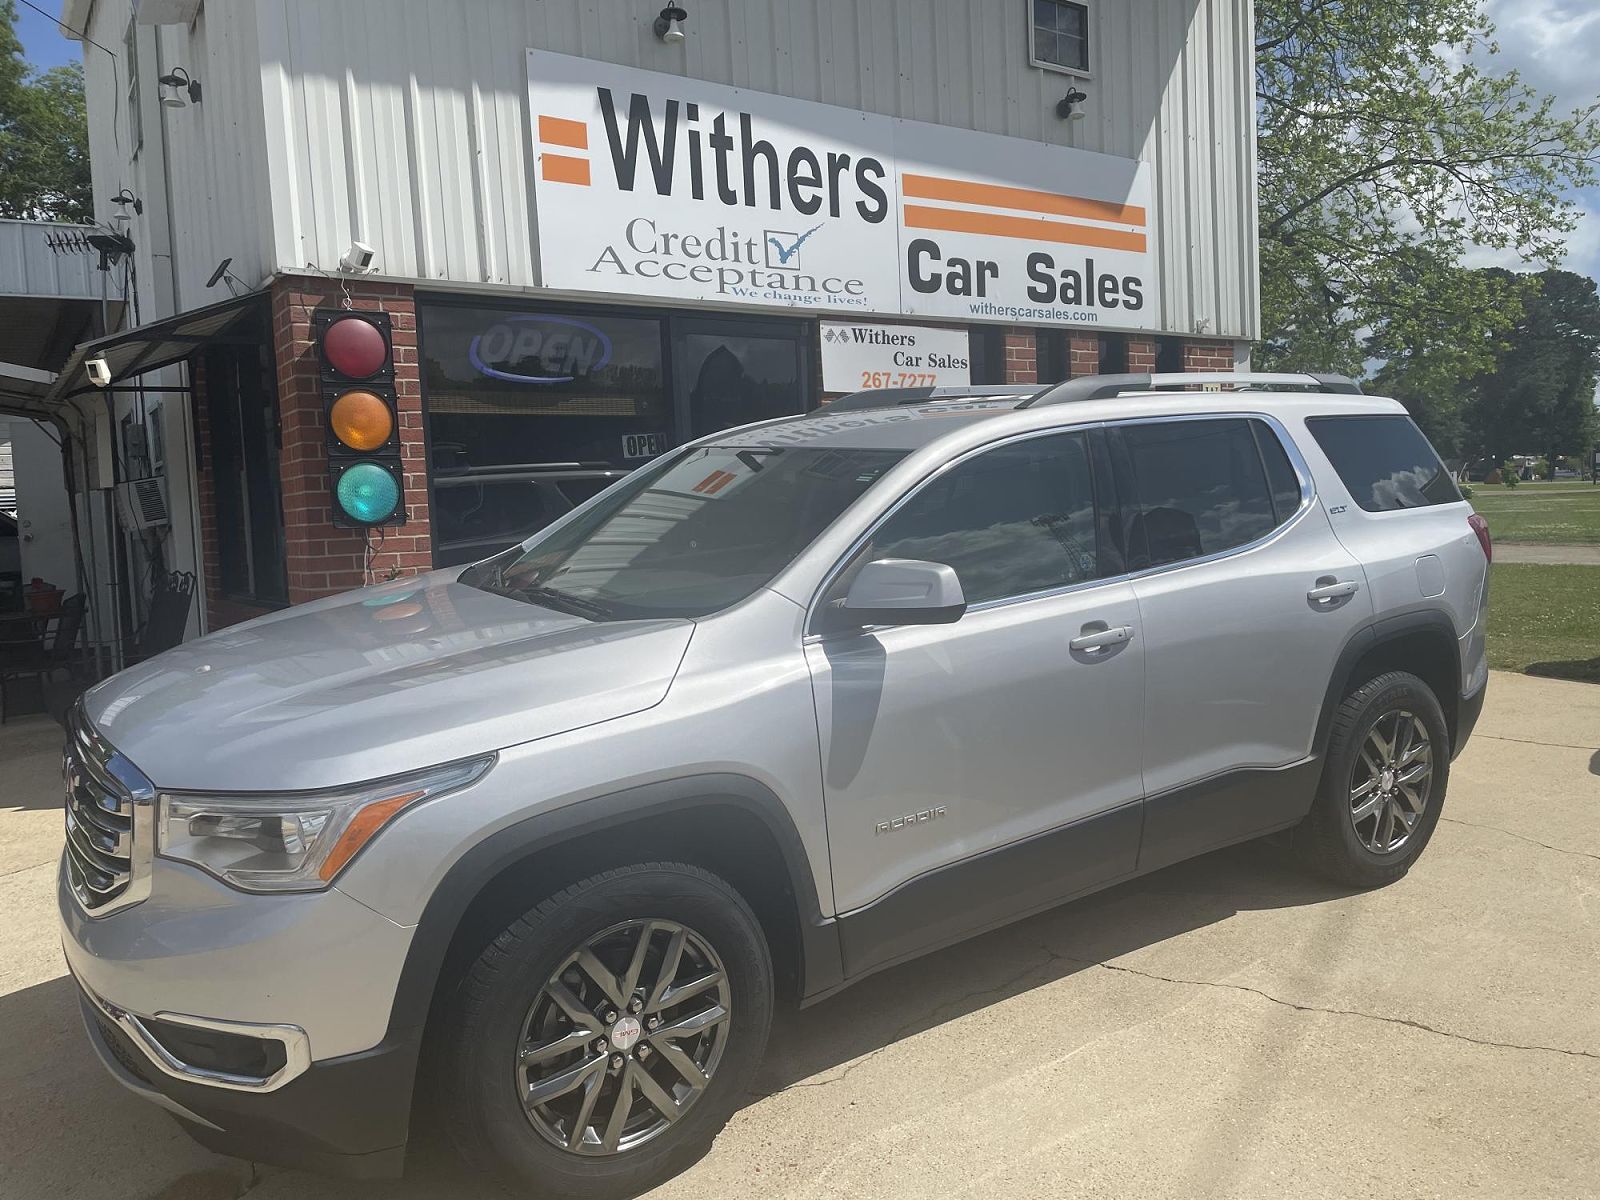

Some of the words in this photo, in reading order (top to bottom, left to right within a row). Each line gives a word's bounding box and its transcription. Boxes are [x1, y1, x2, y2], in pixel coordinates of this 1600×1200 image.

[597, 86, 888, 223] Withers
[626, 217, 759, 265] Credit
[586, 245, 864, 295] Acceptance
[907, 238, 999, 298] Car
[1026, 252, 1143, 311] Sales
[731, 286, 758, 298] We
[763, 290, 822, 305] change
[827, 294, 867, 306] lives!
[969, 302, 1098, 322] witherscarsales.com
[479, 323, 598, 377] OPEN
[851, 327, 916, 346] Withers
[893, 351, 922, 367] Car
[927, 353, 968, 369] Sales
[862, 371, 937, 389] 267-7277
[875, 805, 948, 834] ACADIA
